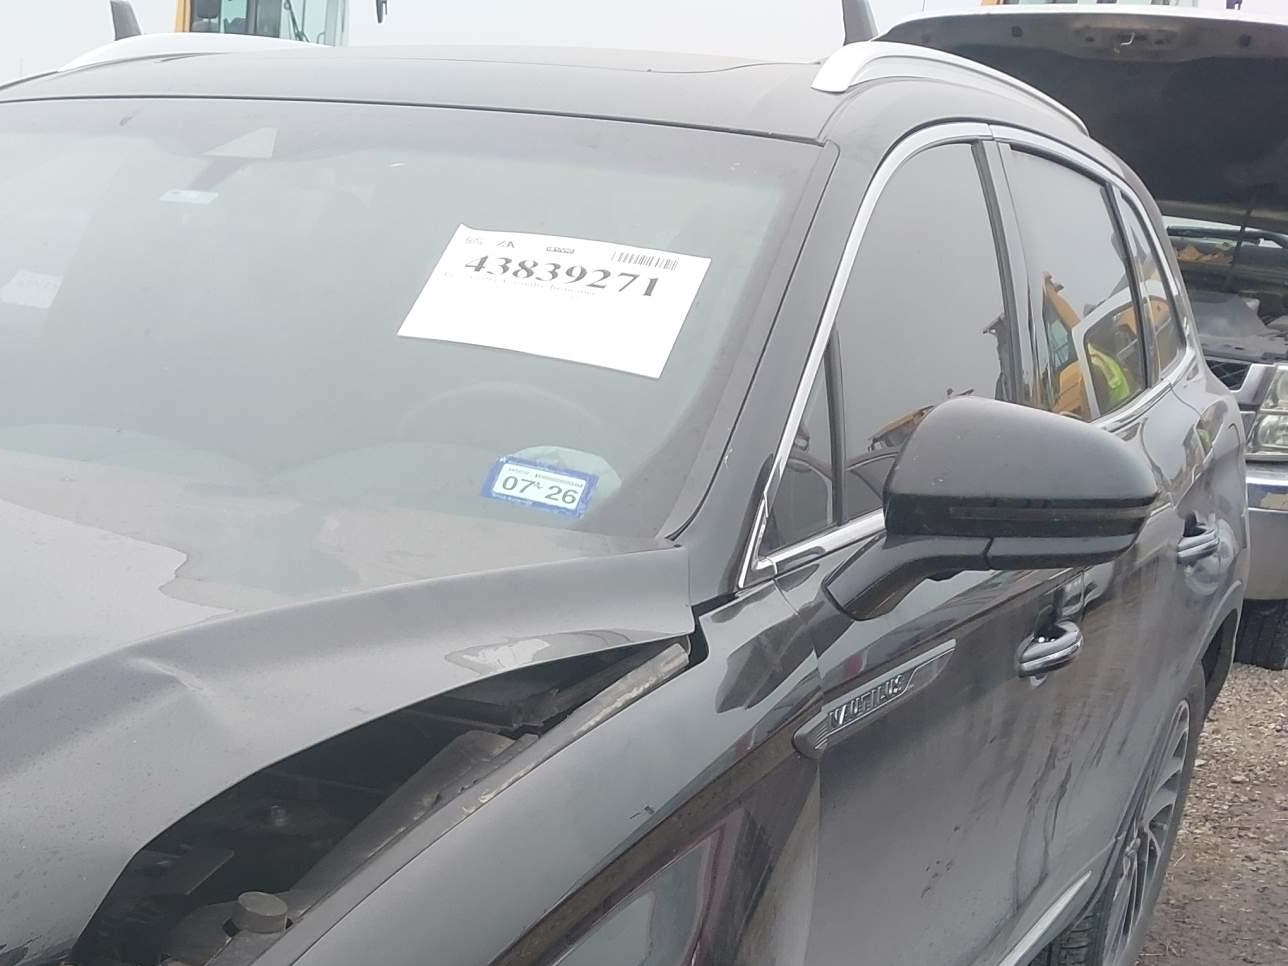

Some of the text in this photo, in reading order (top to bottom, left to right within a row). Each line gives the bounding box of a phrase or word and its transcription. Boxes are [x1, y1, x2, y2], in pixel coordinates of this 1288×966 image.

[464, 254, 659, 297] 43839271
[502, 475, 537, 494] 07
[544, 485, 579, 504] 26
